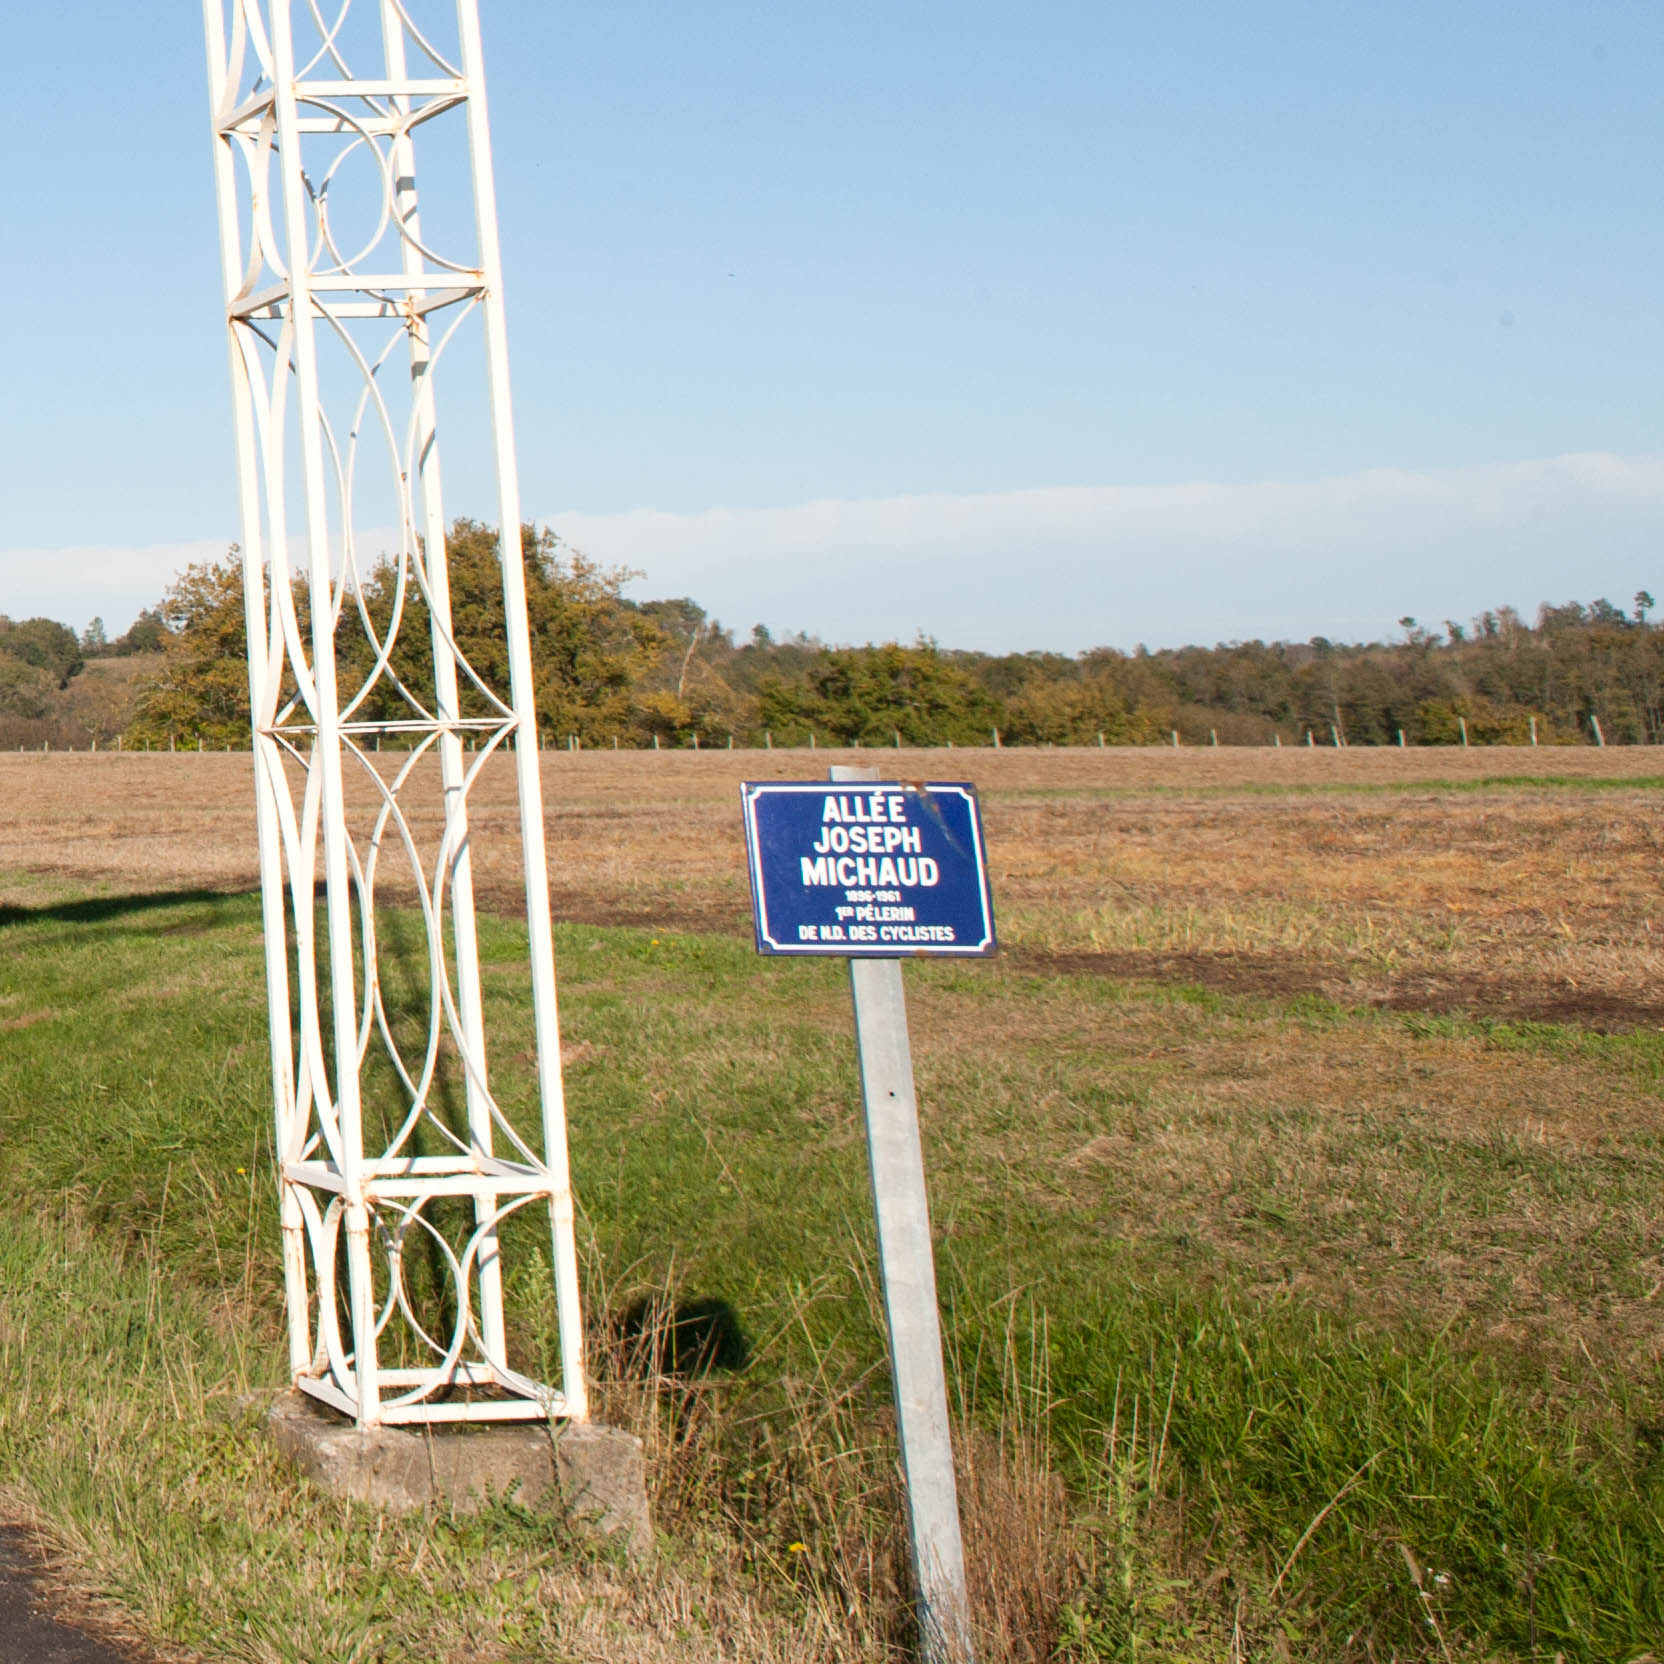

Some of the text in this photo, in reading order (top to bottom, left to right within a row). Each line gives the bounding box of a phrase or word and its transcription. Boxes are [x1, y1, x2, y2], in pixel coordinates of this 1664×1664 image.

[822, 791, 906, 823] ALLÉE
[813, 826, 921, 854] JOSEPH
[800, 857, 939, 887] MICHAUD
[798, 925, 955, 942] DE N.D. DES CYCLISTES
